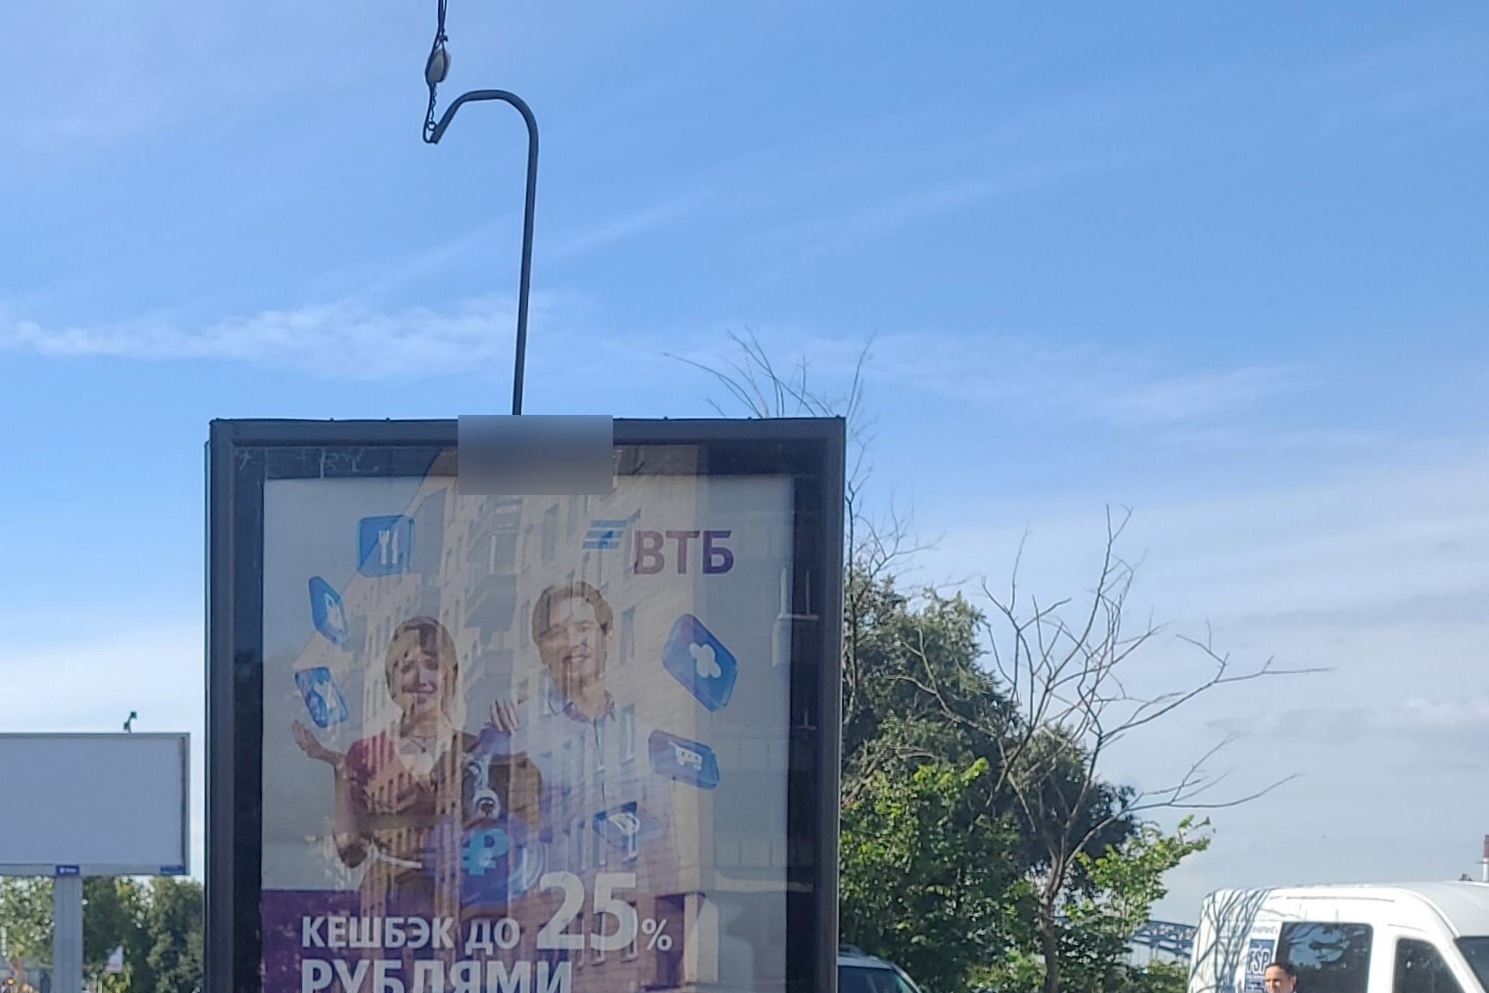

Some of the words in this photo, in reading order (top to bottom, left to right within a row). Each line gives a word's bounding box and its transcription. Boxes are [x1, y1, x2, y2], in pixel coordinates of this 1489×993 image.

[633, 529, 735, 575] ВТБ
[301, 916, 455, 949] КЕШБЭК
[465, 917, 521, 955] ДО
[536, 872, 673, 951] 25%
